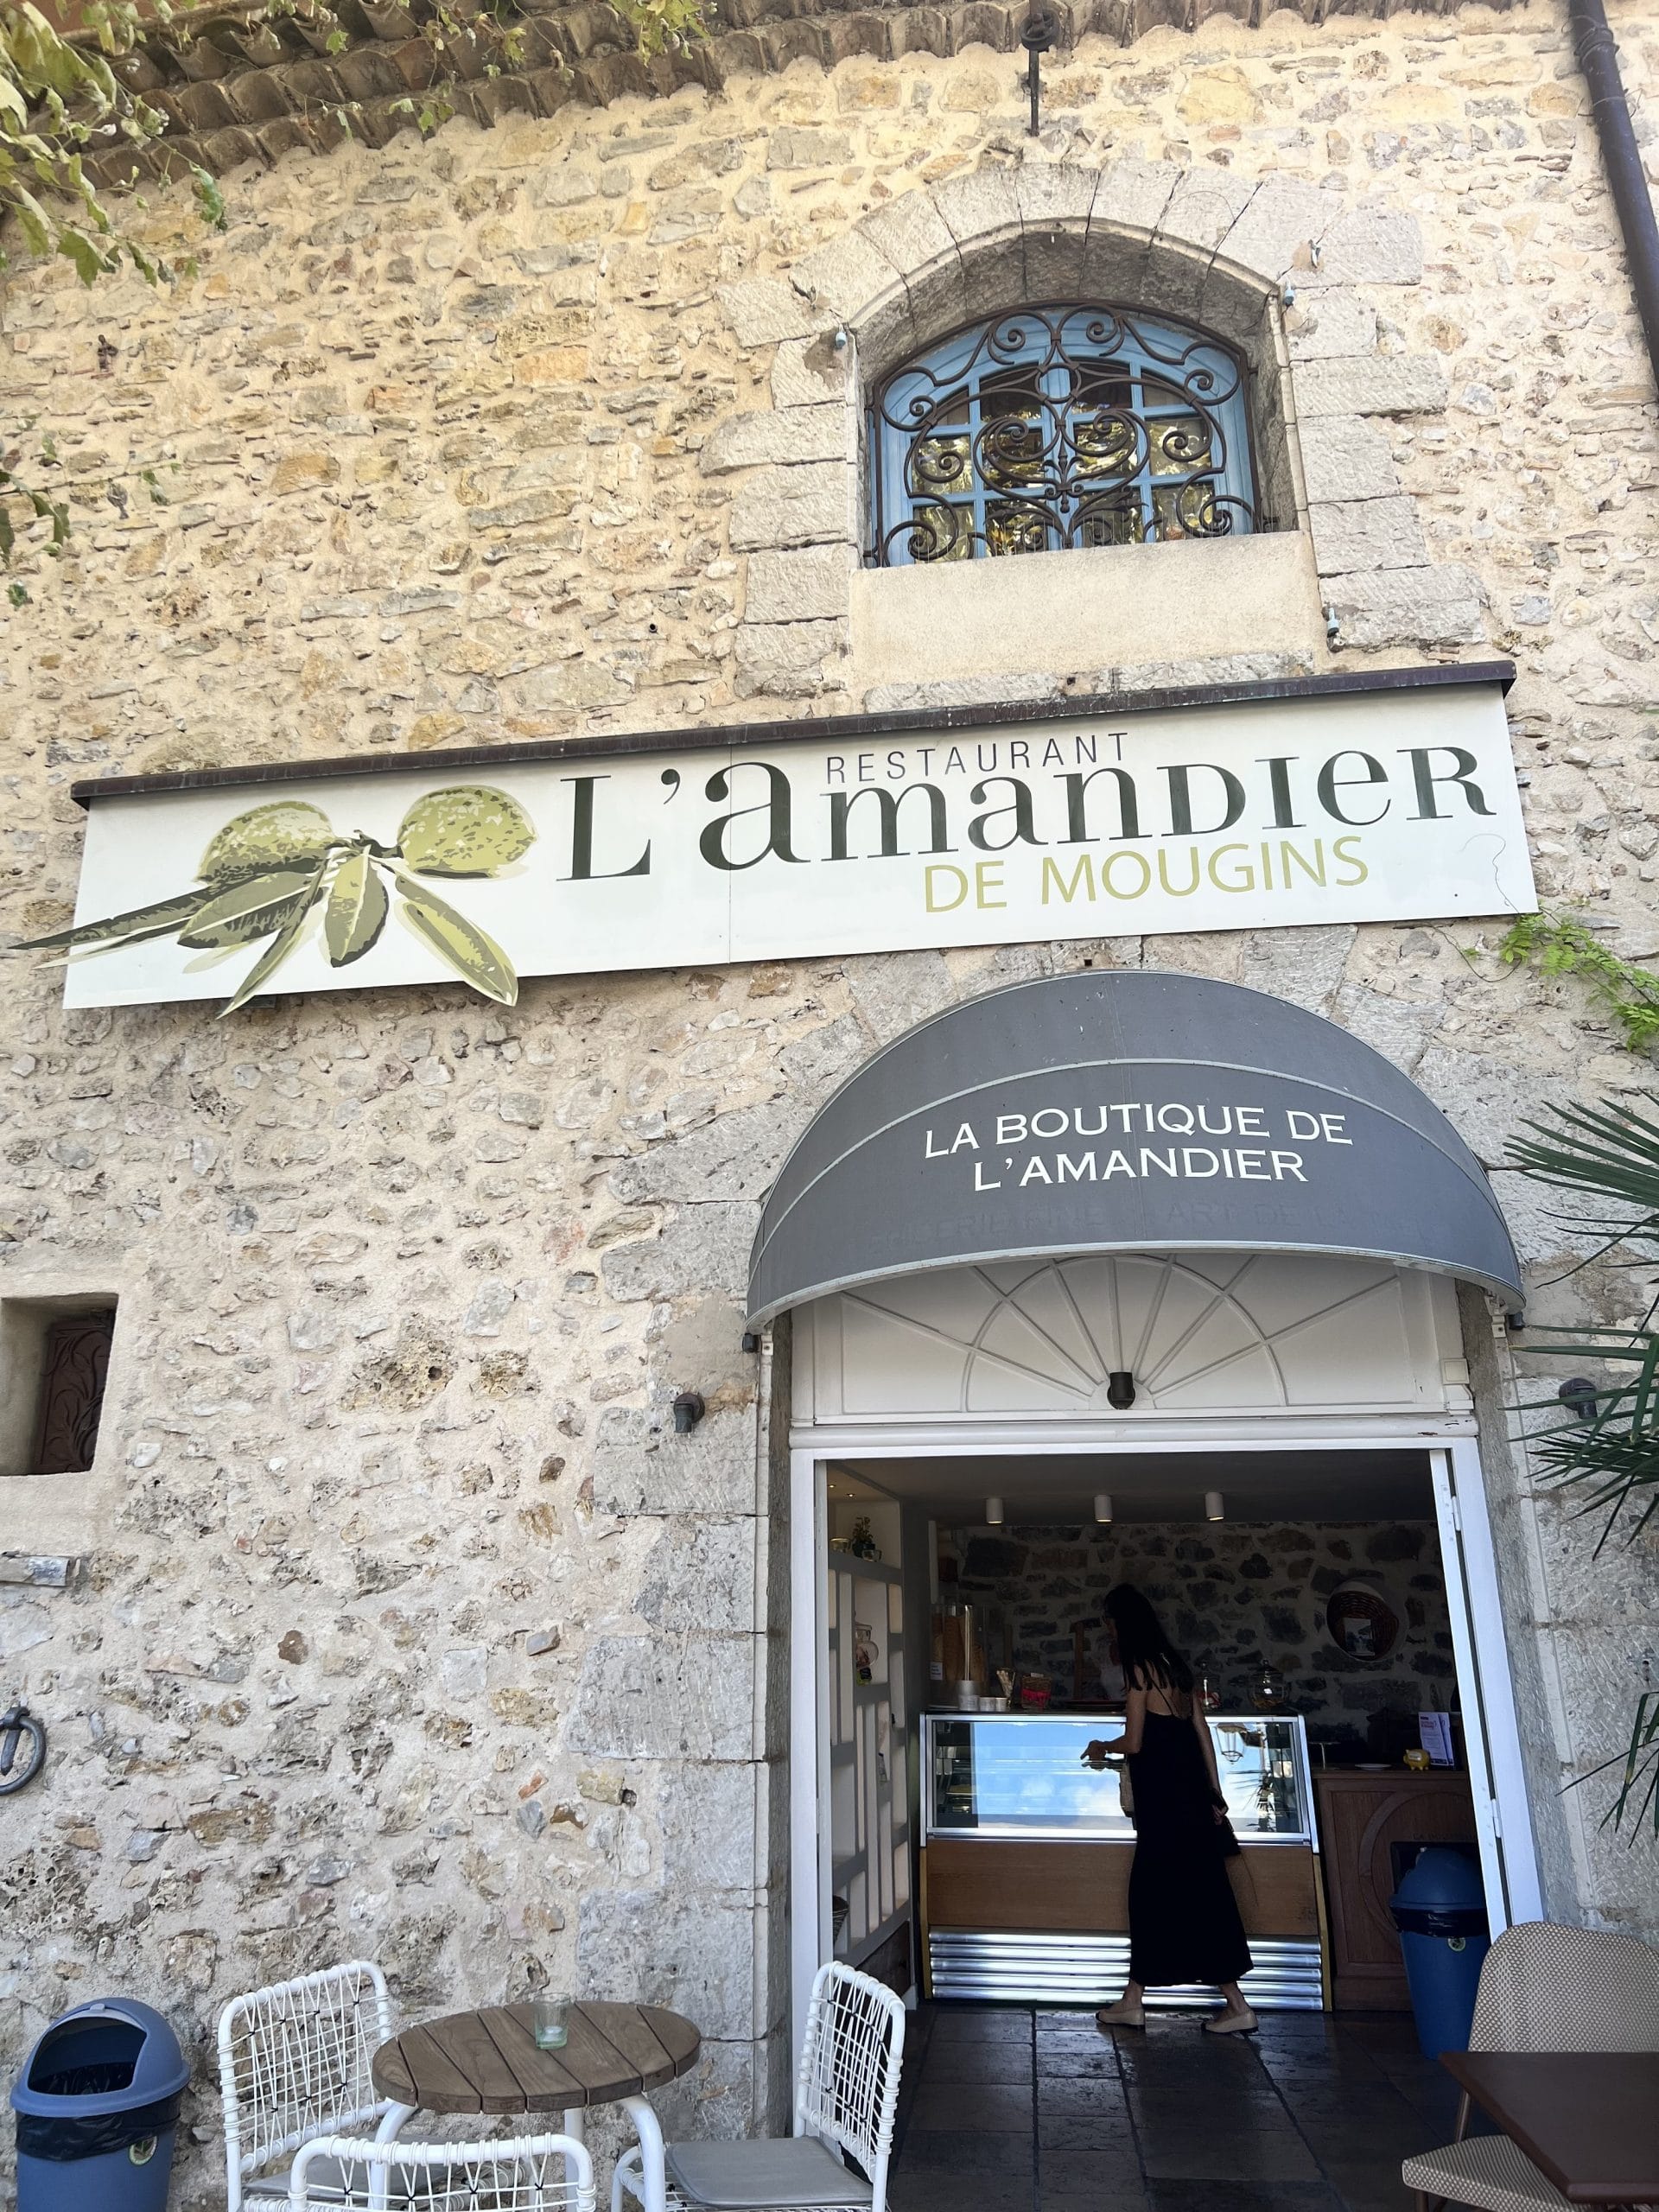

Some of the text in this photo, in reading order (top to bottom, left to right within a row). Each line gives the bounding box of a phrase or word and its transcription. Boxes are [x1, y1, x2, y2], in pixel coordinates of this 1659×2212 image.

[827, 732, 1128, 785] RESTAURANT
[925, 836, 1370, 913] DE MOUGINS
[925, 1103, 1353, 1159] LA BOUTIQUE DE
[974, 1147, 1309, 1192] L'AMANDIER
